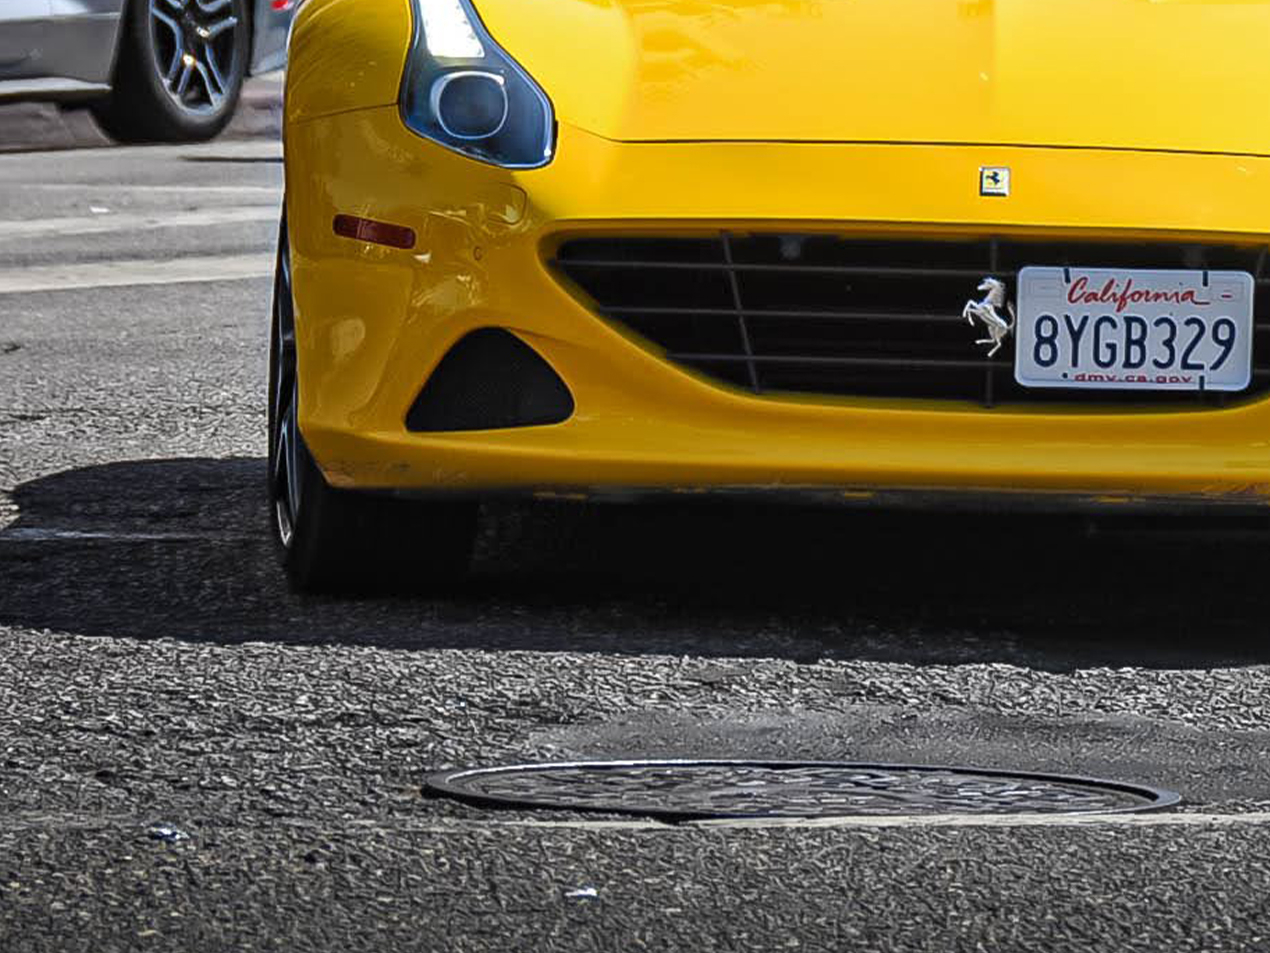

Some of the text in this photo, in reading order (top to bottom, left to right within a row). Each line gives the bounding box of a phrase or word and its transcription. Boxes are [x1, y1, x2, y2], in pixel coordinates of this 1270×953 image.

[1067, 277, 1210, 312] California
[1033, 314, 1236, 371] 8YGB329
[1074, 372, 1192, 383] dmv.ca.gov
